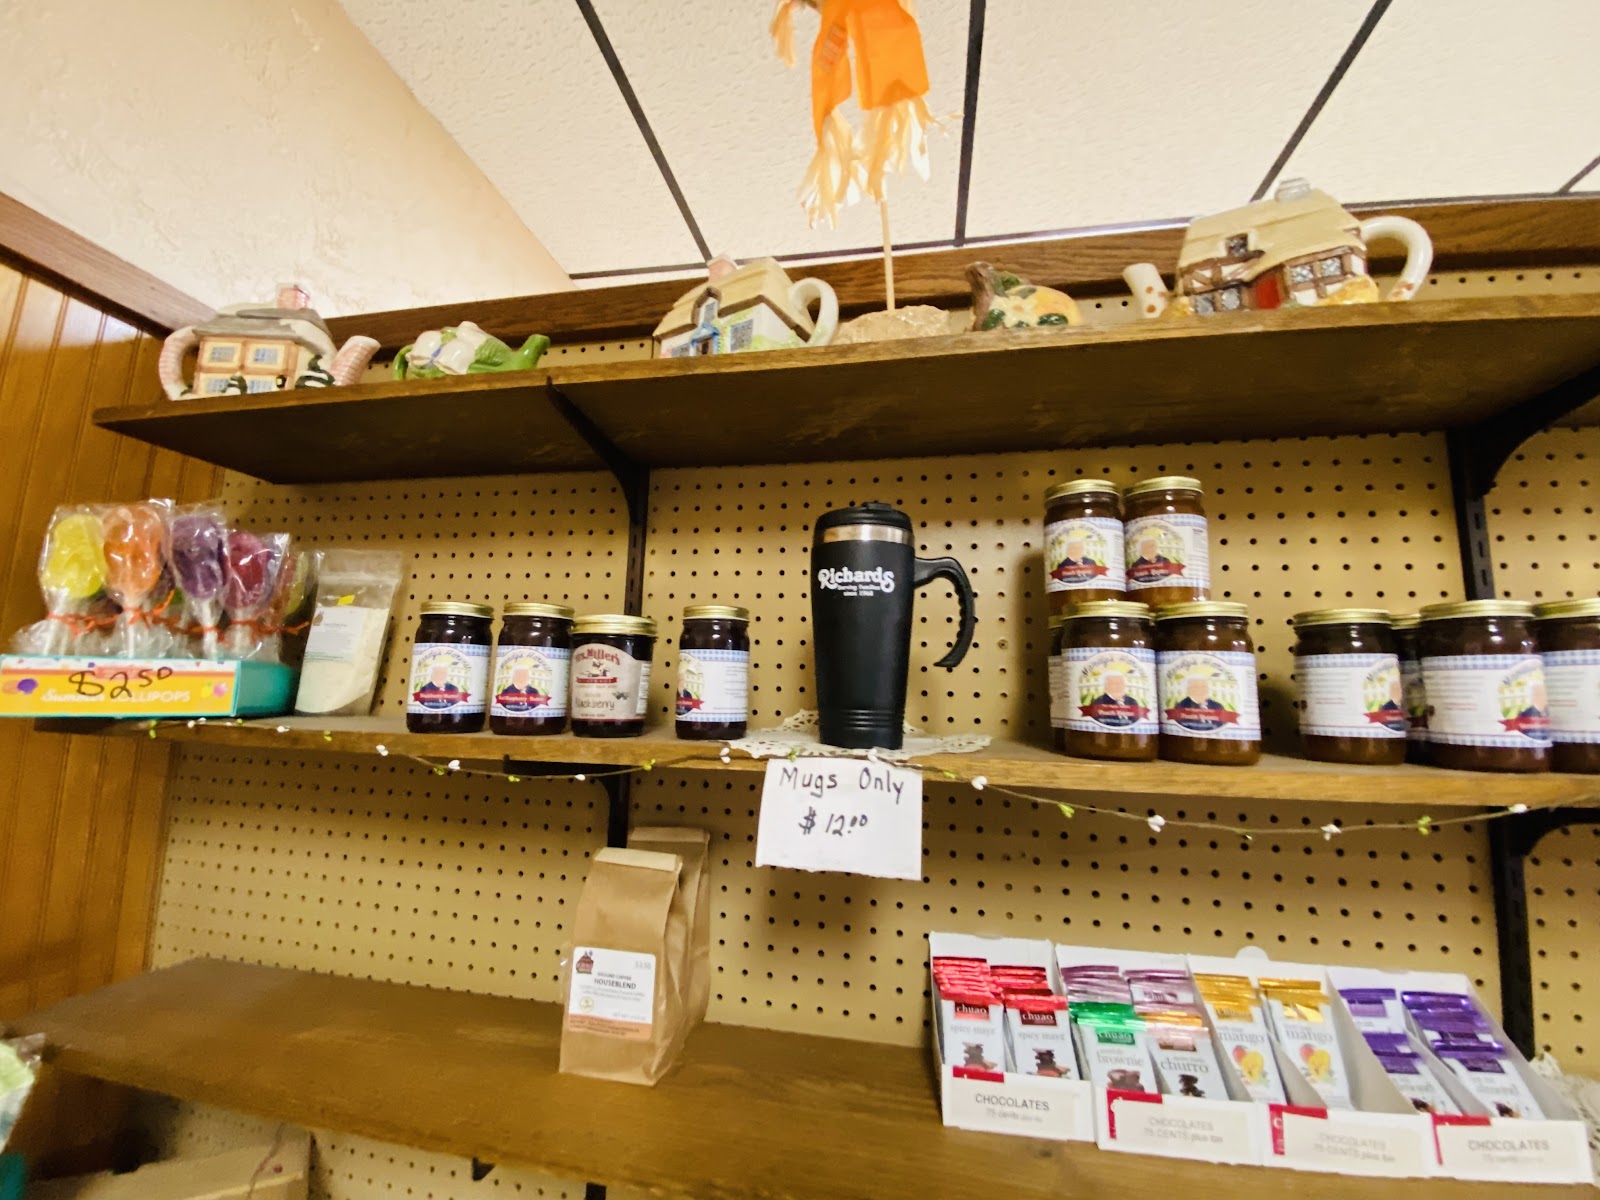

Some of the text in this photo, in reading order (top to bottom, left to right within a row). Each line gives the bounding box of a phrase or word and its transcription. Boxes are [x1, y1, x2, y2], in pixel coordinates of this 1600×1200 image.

[817, 566, 895, 593] Richards
[780, 766, 904, 804] Mugs Only
[594, 978, 637, 990] HOUSEBLEND
[956, 1004, 987, 1014] chuao
[1022, 1011, 1054, 1021] chuao
[1097, 1051, 1142, 1067] brownie
[1160, 1056, 1209, 1073] churro
[975, 1093, 1050, 1111] CHOCOLATES
[1149, 1117, 1214, 1131] CHOCOLATES
[1468, 1139, 1550, 1151] CHOCOLATES
